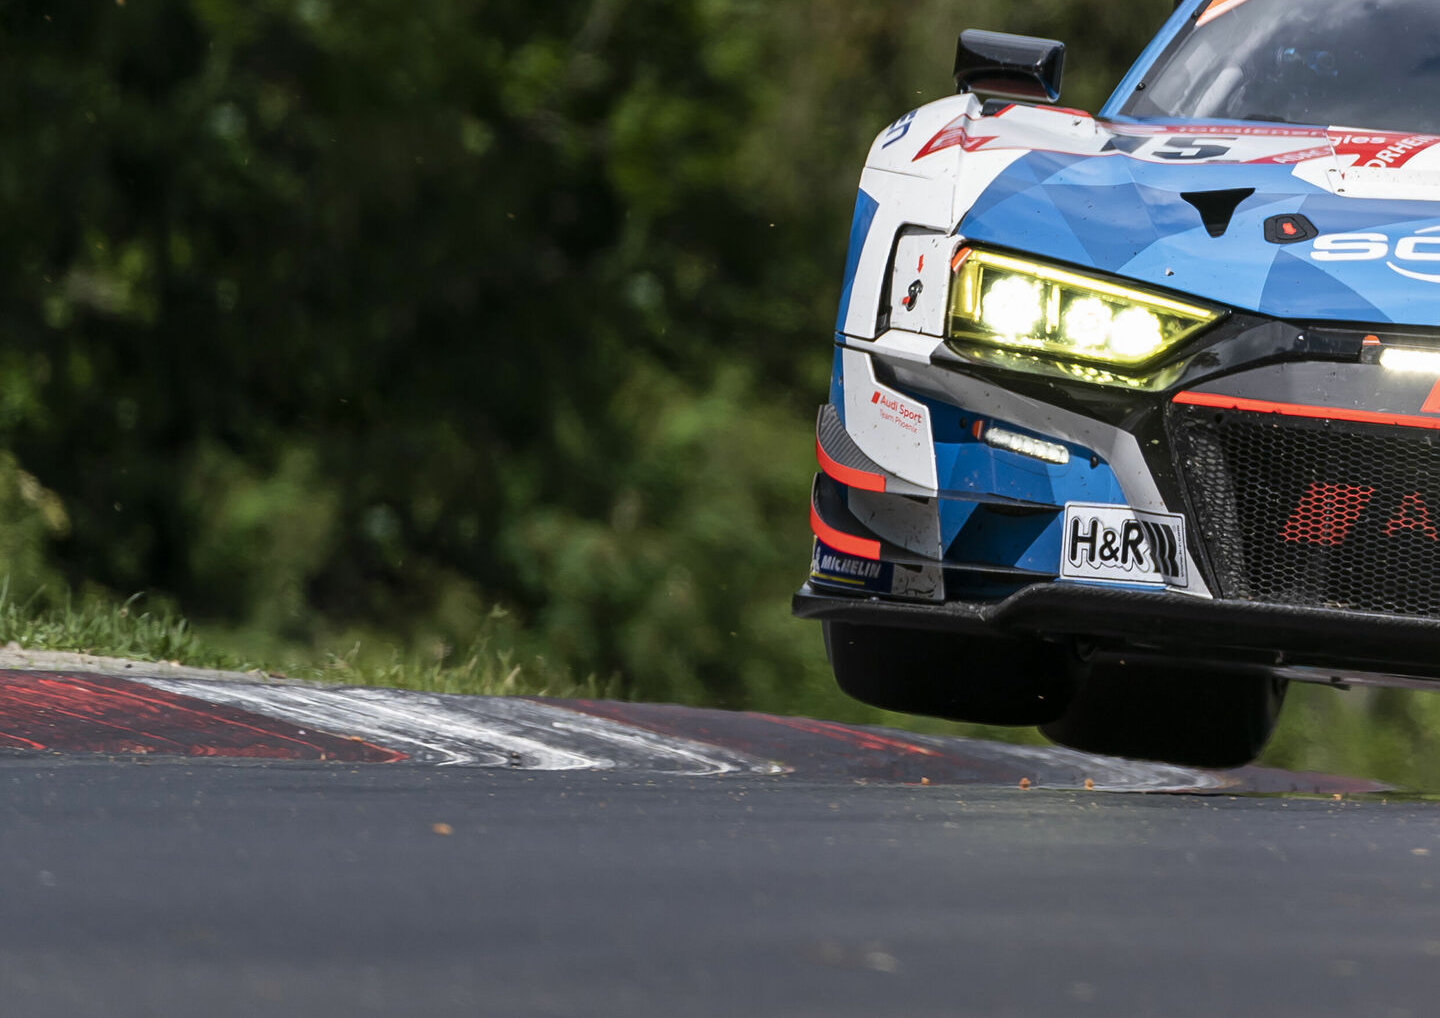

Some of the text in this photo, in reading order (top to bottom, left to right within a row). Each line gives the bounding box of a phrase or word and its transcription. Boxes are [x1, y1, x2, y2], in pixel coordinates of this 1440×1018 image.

[880, 394, 923, 424] Audi Sport
[1068, 517, 1149, 570] H&R
[820, 554, 882, 579] MICHELIN
